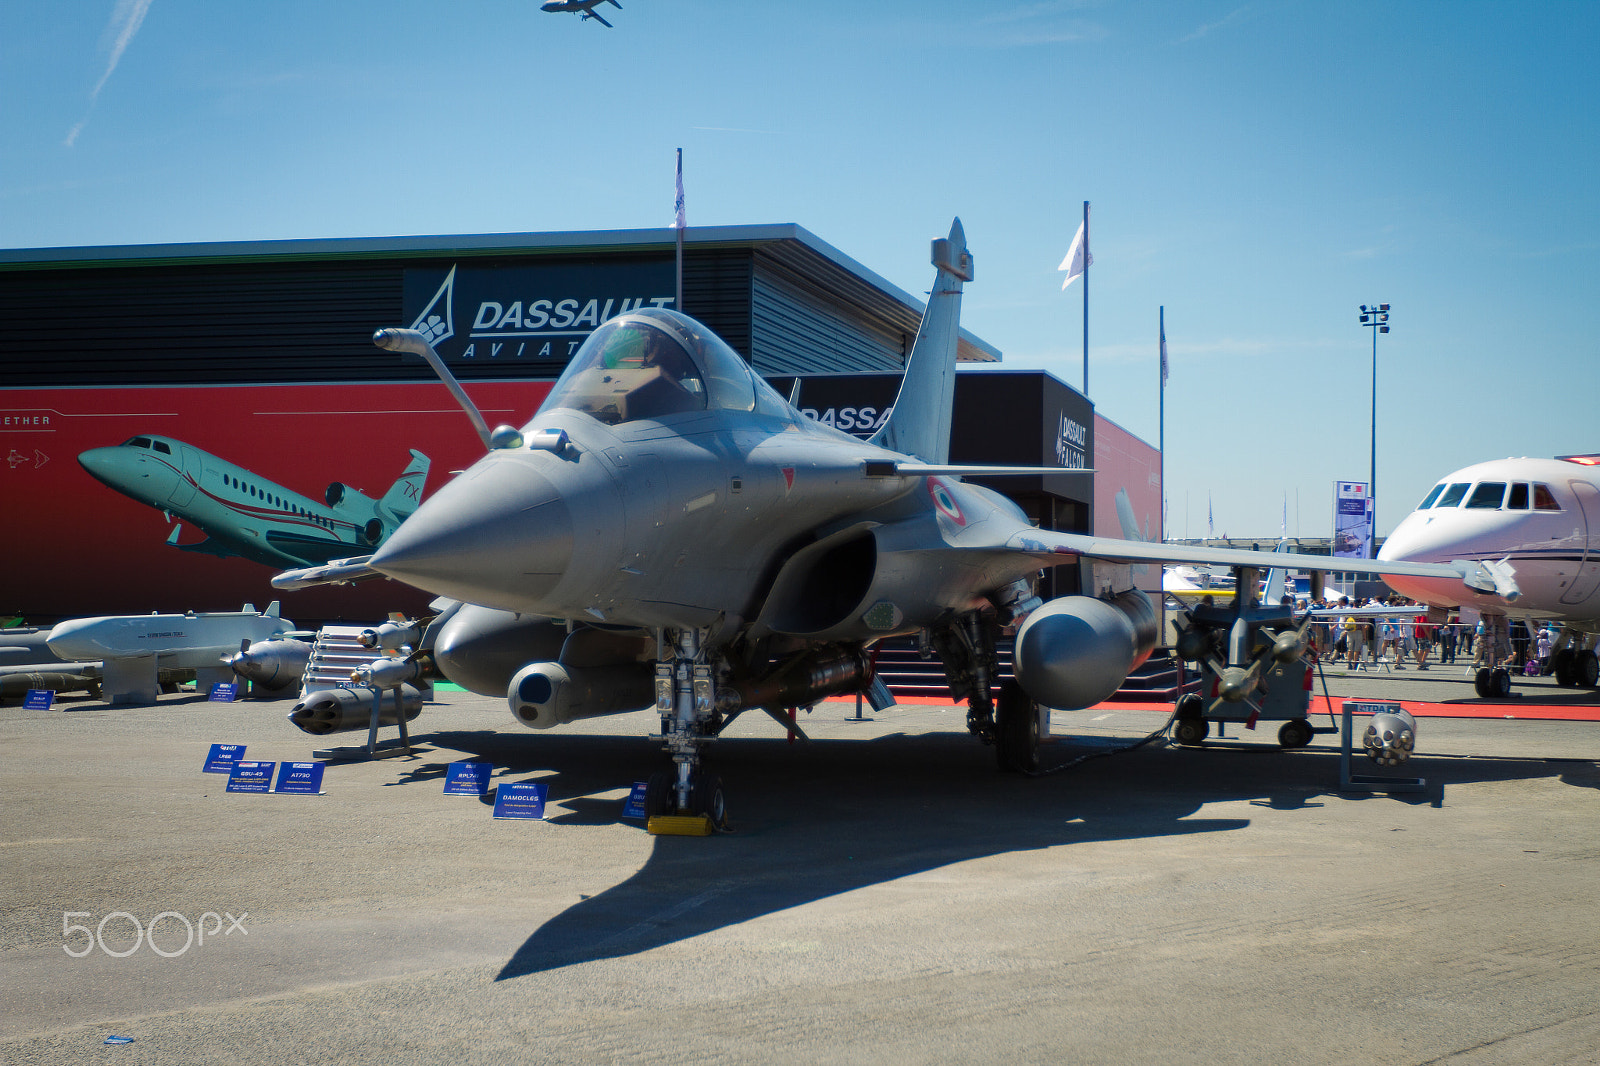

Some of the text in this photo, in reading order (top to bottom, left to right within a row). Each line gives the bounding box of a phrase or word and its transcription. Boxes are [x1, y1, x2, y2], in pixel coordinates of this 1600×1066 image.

[1063, 416, 1086, 447] DASSAULT
[1061, 445, 1085, 469] FALCON
[403, 480, 420, 502] 7X
[502, 794, 539, 802] DAMOCLES
